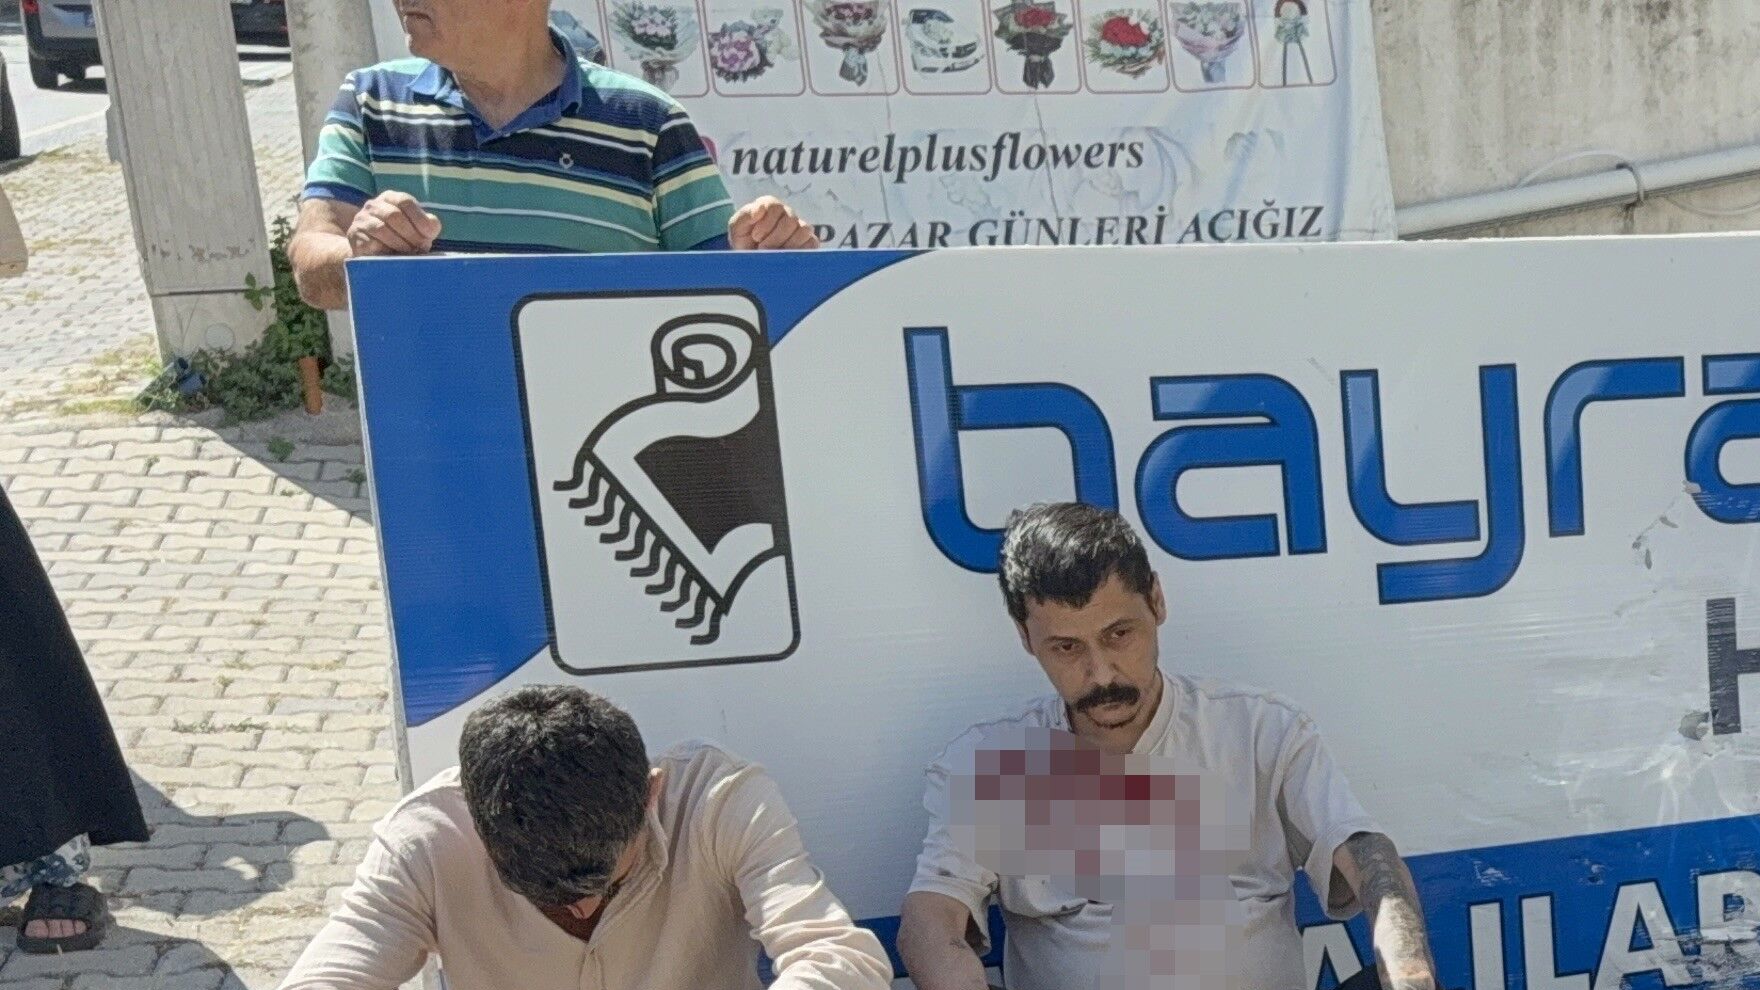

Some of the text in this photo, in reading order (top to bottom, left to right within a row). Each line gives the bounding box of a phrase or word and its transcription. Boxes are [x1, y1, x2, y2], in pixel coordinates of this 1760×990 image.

[732, 132, 1145, 184] naturelplusflowers
[813, 220, 953, 248] PAZAR
[968, 205, 1168, 246] GÜNLERİ
